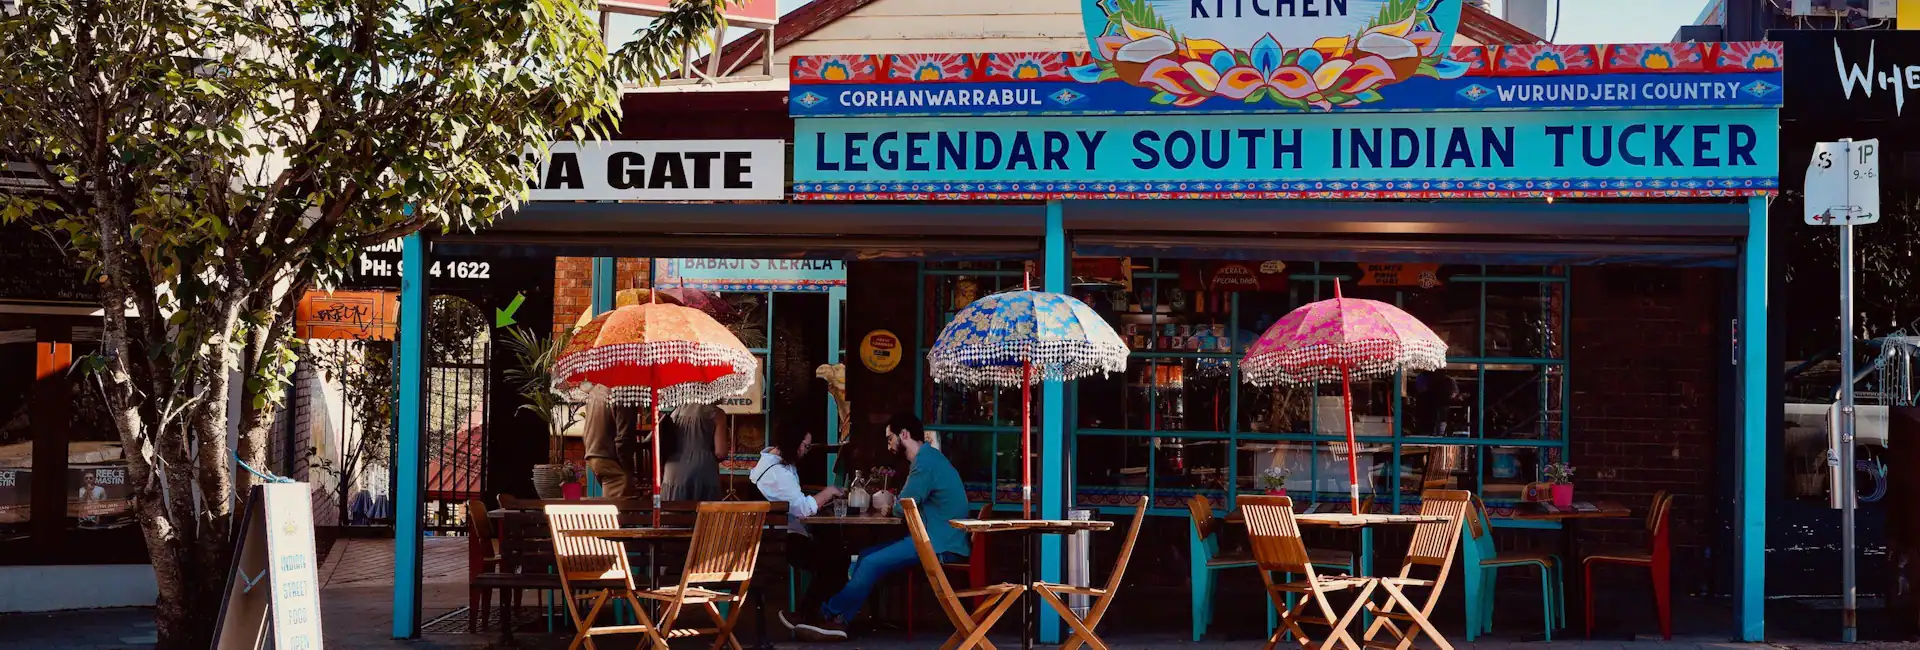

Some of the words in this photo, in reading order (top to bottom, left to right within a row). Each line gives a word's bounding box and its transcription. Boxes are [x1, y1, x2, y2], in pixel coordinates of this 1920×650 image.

[1190, 0, 1348, 18] KITCHEN
[839, 88, 1042, 107] CORHANWARRABUL
[1496, 83, 1636, 102] WURUNDJERI
[1642, 81, 1741, 100] COUNTRY
[816, 130, 1107, 172] LEGENDARY
[1131, 128, 1303, 170] SOUTH
[1331, 126, 1515, 169] INDIAN
[1544, 123, 1758, 168] TUCKER
[1858, 144, 1874, 164] 1P
[607, 151, 753, 190] GATE
[361, 260, 392, 277] PH:
[447, 261, 490, 279] 1622
[684, 258, 760, 270] BABAJIS
[768, 259, 832, 270] KERALA
[95, 469, 125, 478] REECE
[95, 477, 125, 485] MASTIN
[280, 554, 307, 572] INDIAN
[283, 580, 308, 599] STREET
[288, 607, 308, 625] FOOD
